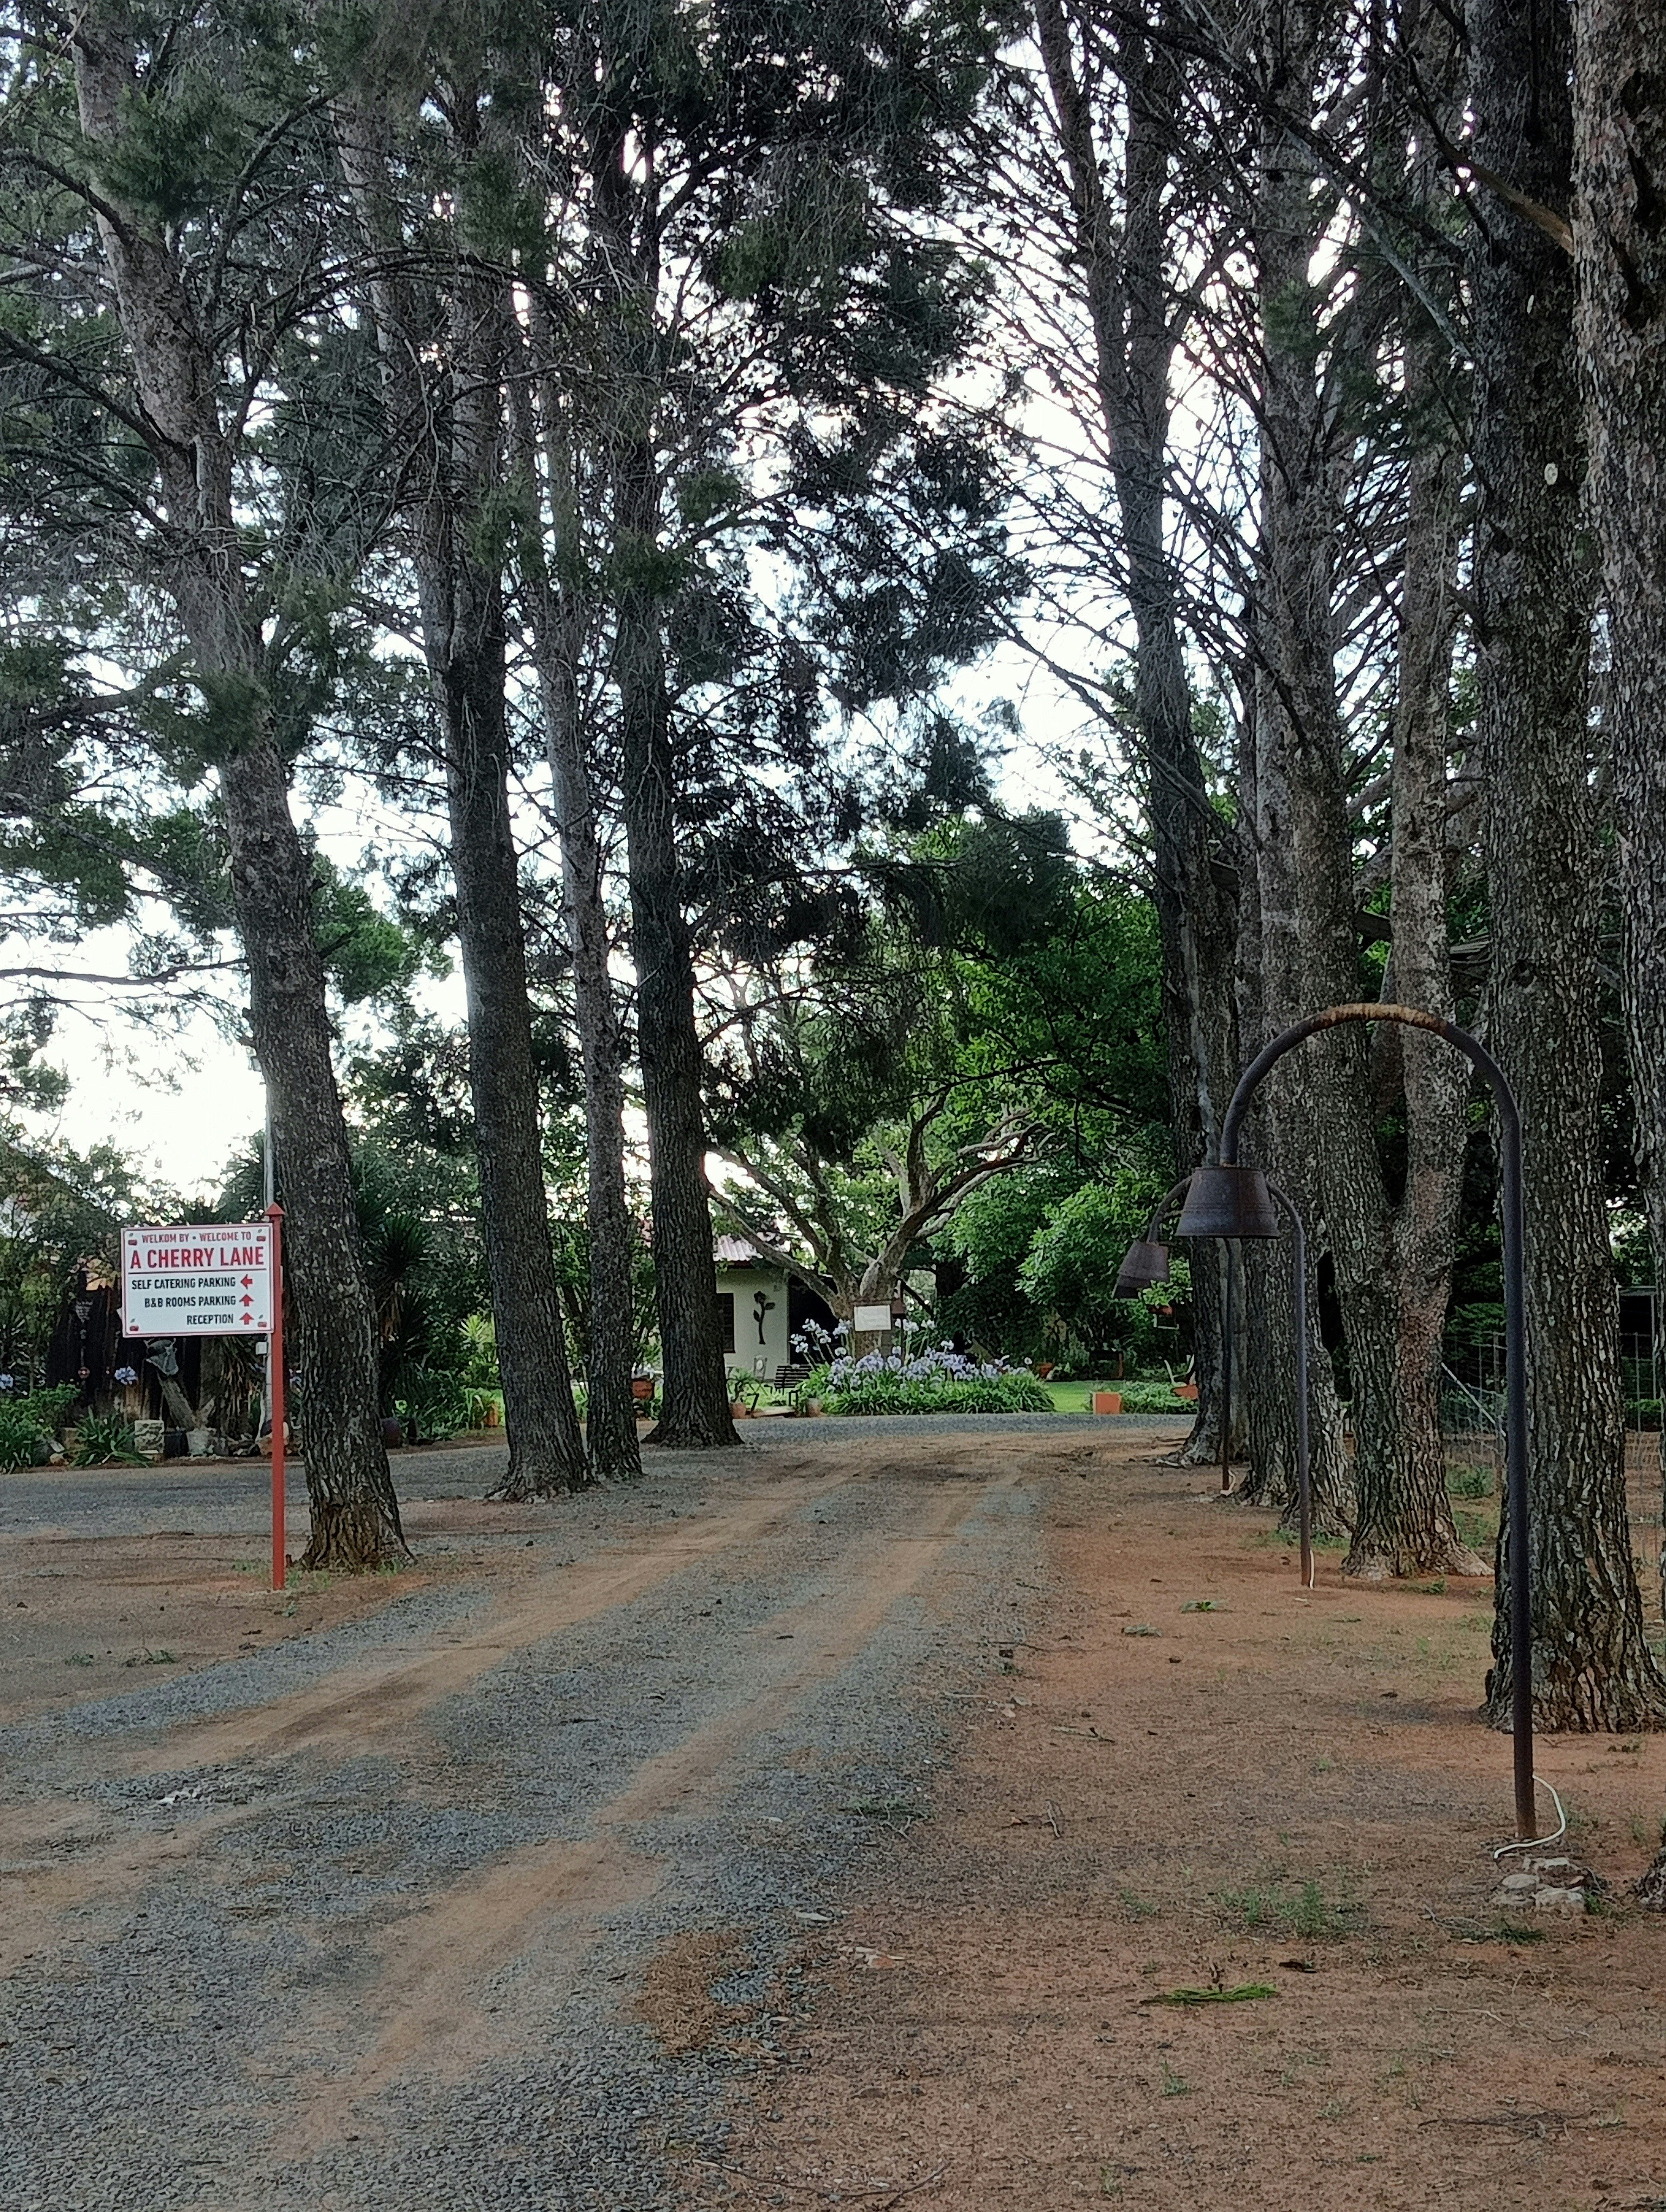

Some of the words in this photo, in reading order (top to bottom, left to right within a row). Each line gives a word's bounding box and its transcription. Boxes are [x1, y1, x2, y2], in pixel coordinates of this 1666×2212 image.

[142, 1233, 177, 1243] WELKOM
[179, 1233, 189, 1242] BY
[199, 1232, 239, 1242] WELCOME
[241, 1232, 252, 1240] TO
[130, 1250, 141, 1269] A
[147, 1248, 214, 1268] CHERRY
[220, 1246, 264, 1266] LANE
[132, 1279, 151, 1290] SELF
[155, 1278, 196, 1289] CATERING
[198, 1277, 236, 1288] PARKING
[145, 1298, 163, 1308] B&B
[166, 1297, 196, 1307] ROOMS
[198, 1296, 236, 1306] PARKING
[187, 1314, 234, 1325] RECEPTION
